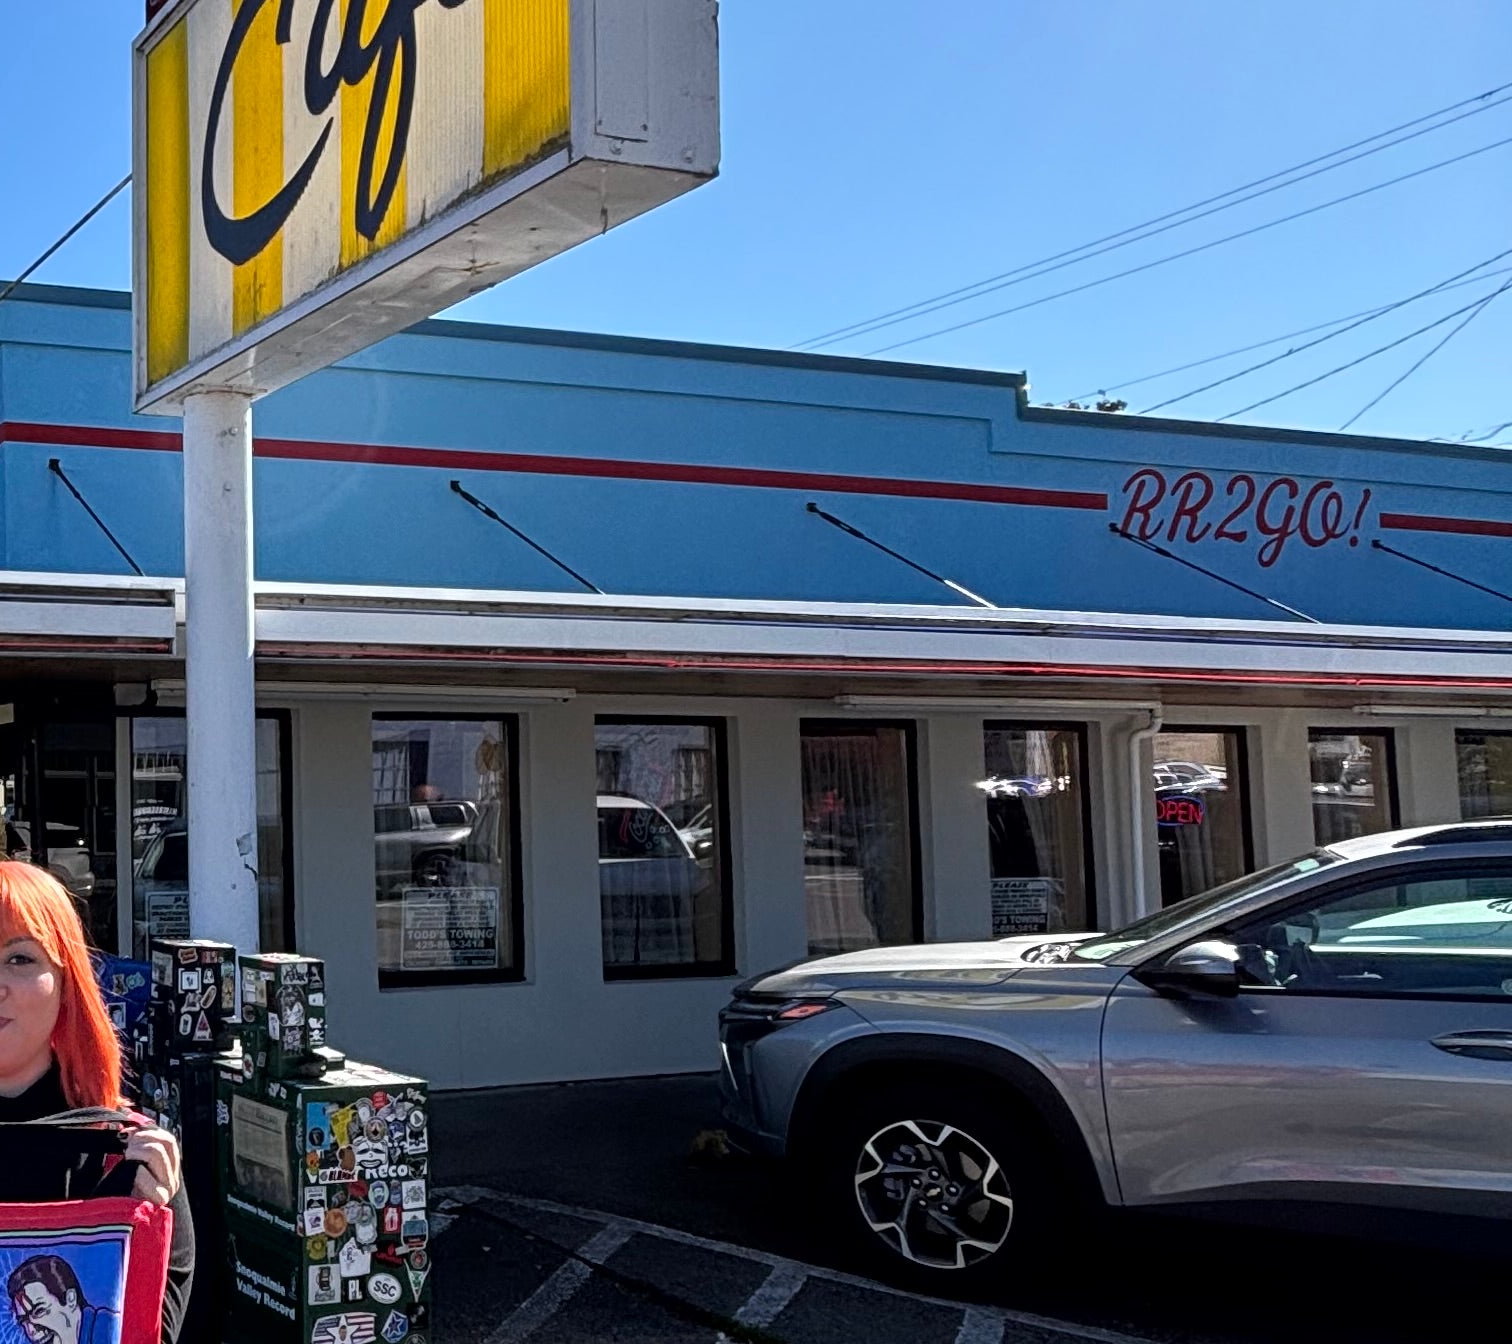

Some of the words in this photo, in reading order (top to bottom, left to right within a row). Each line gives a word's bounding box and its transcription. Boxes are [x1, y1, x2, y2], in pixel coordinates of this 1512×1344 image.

[1121, 468, 1371, 568] RR2GO!
[407, 929, 447, 940] TODD'S
[449, 928, 494, 940] TOWING
[257, 1205, 275, 1224] Valley
[236, 1260, 287, 1297] Snoqualmie
[236, 1276, 262, 1304] Valley
[373, 1279, 397, 1298] SSC
[263, 1292, 296, 1321] Record
